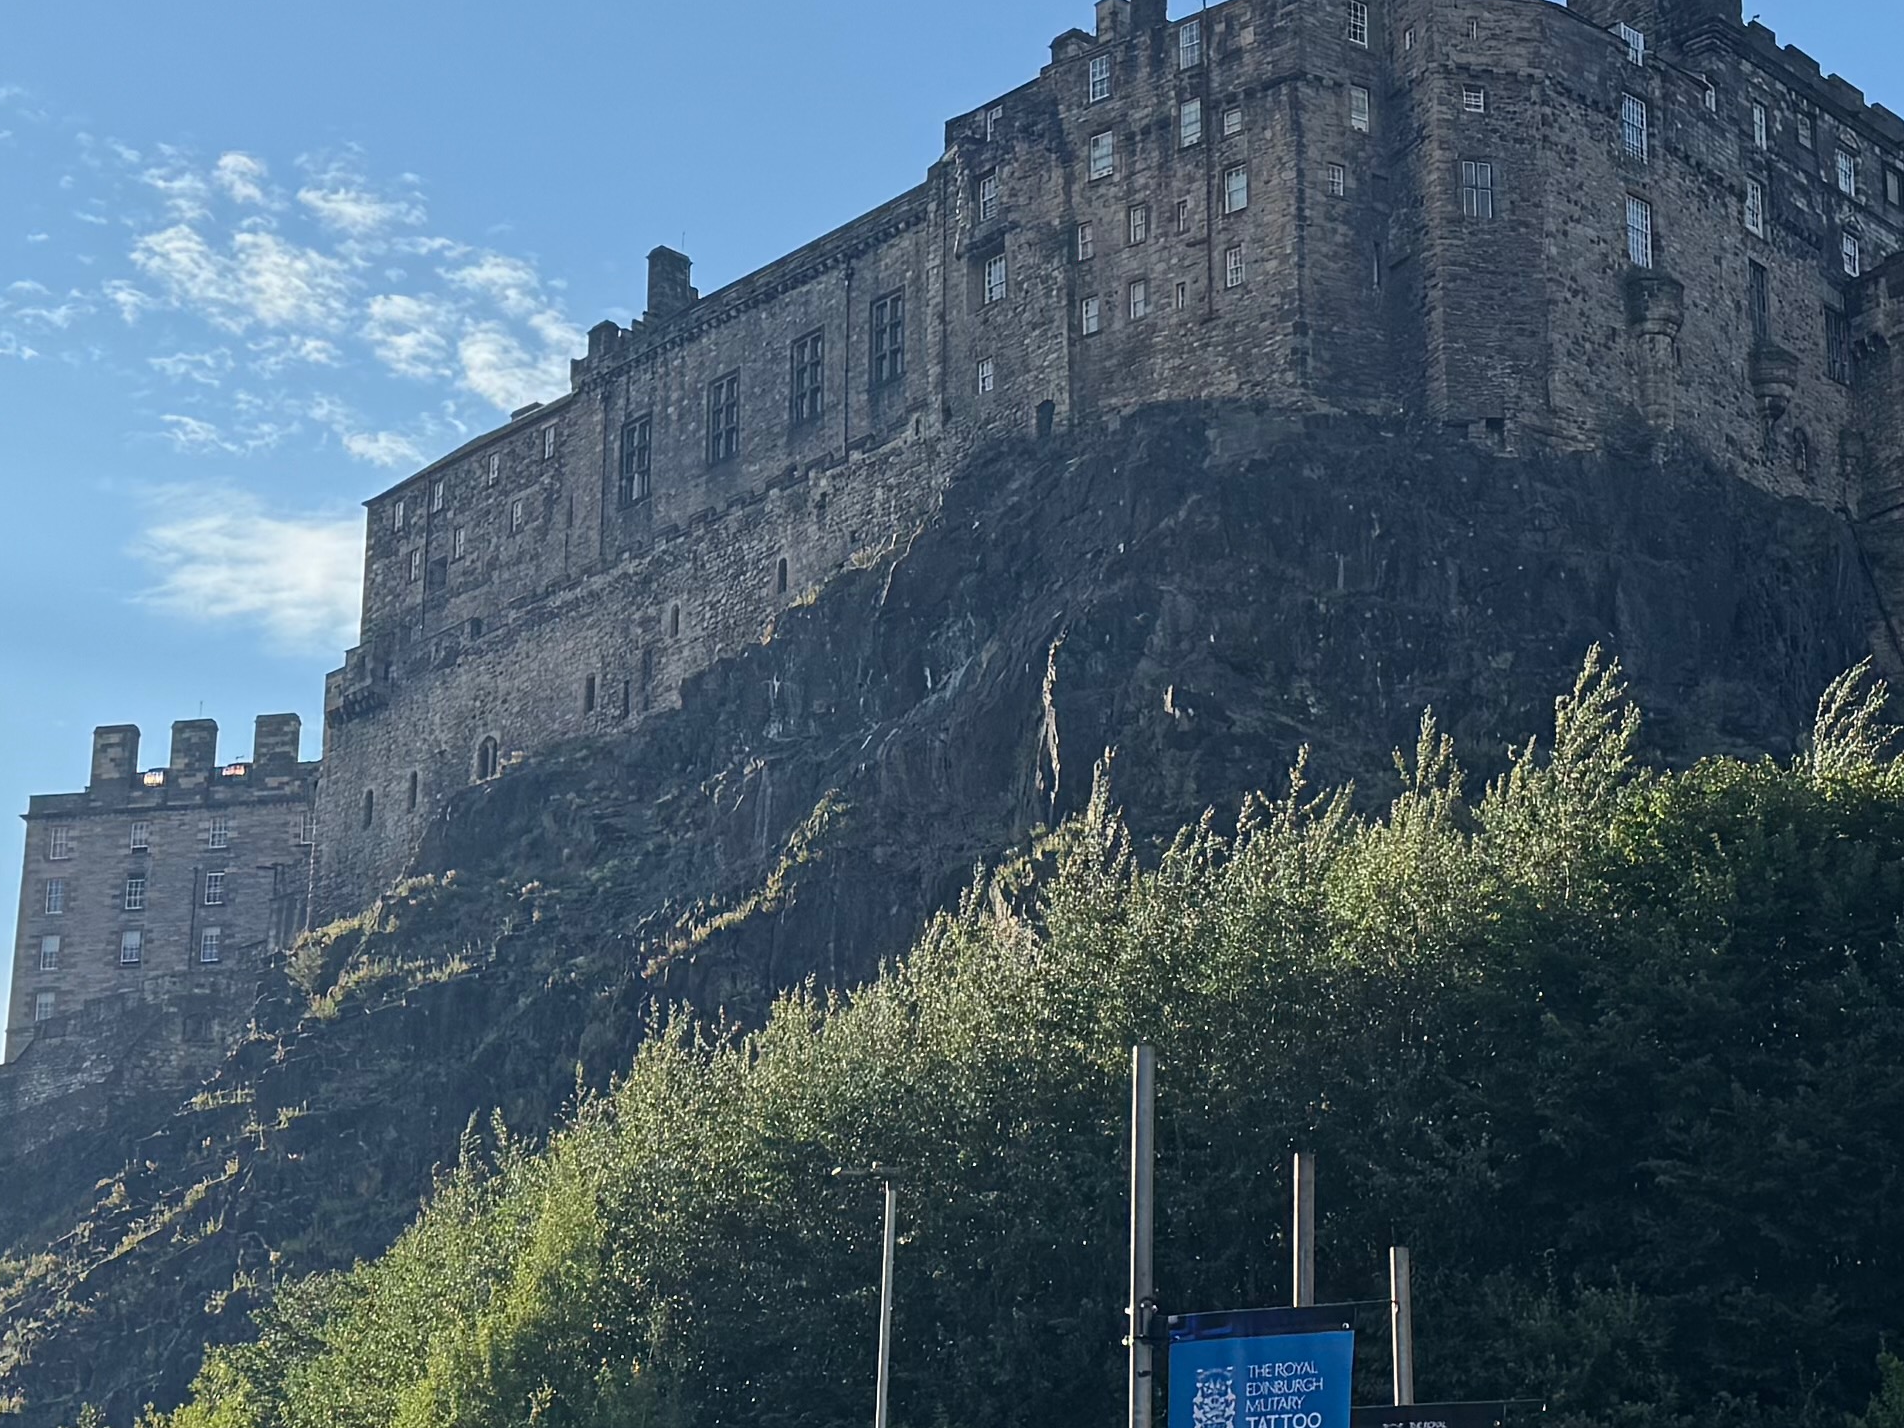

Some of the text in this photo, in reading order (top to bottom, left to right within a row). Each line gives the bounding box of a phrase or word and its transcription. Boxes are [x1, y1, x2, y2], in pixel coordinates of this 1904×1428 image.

[1248, 1360, 1319, 1379] THE ROYAL
[1246, 1377, 1324, 1396] EDINBURGH
